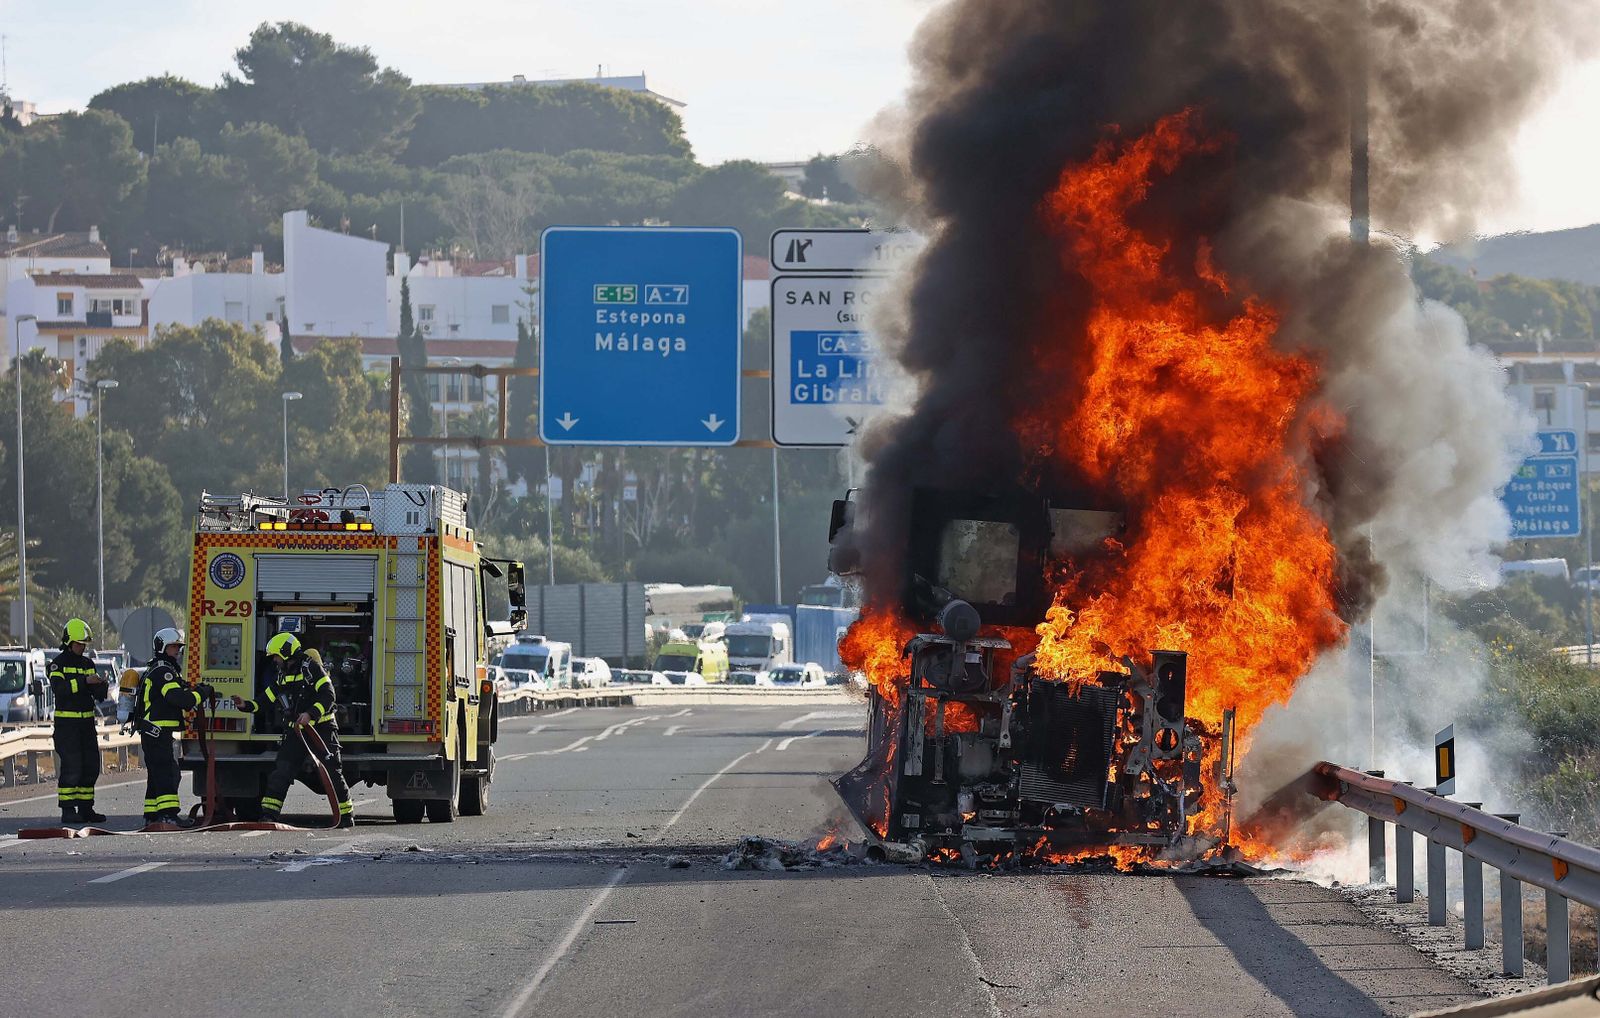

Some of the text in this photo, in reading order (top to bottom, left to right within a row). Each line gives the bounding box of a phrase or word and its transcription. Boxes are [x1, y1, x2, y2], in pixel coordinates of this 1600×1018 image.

[596, 286, 686, 303] E-15 A-7
[785, 290, 831, 305] SAN
[596, 309, 686, 327] Estepona
[837, 310, 866, 324] (sur
[595, 332, 687, 358] Málaga
[821, 337, 872, 352] CA-3
[797, 359, 828, 378] La
[1537, 481, 1571, 492] Roque
[1528, 491, 1557, 502] (sur)
[201, 600, 253, 618] R-29
